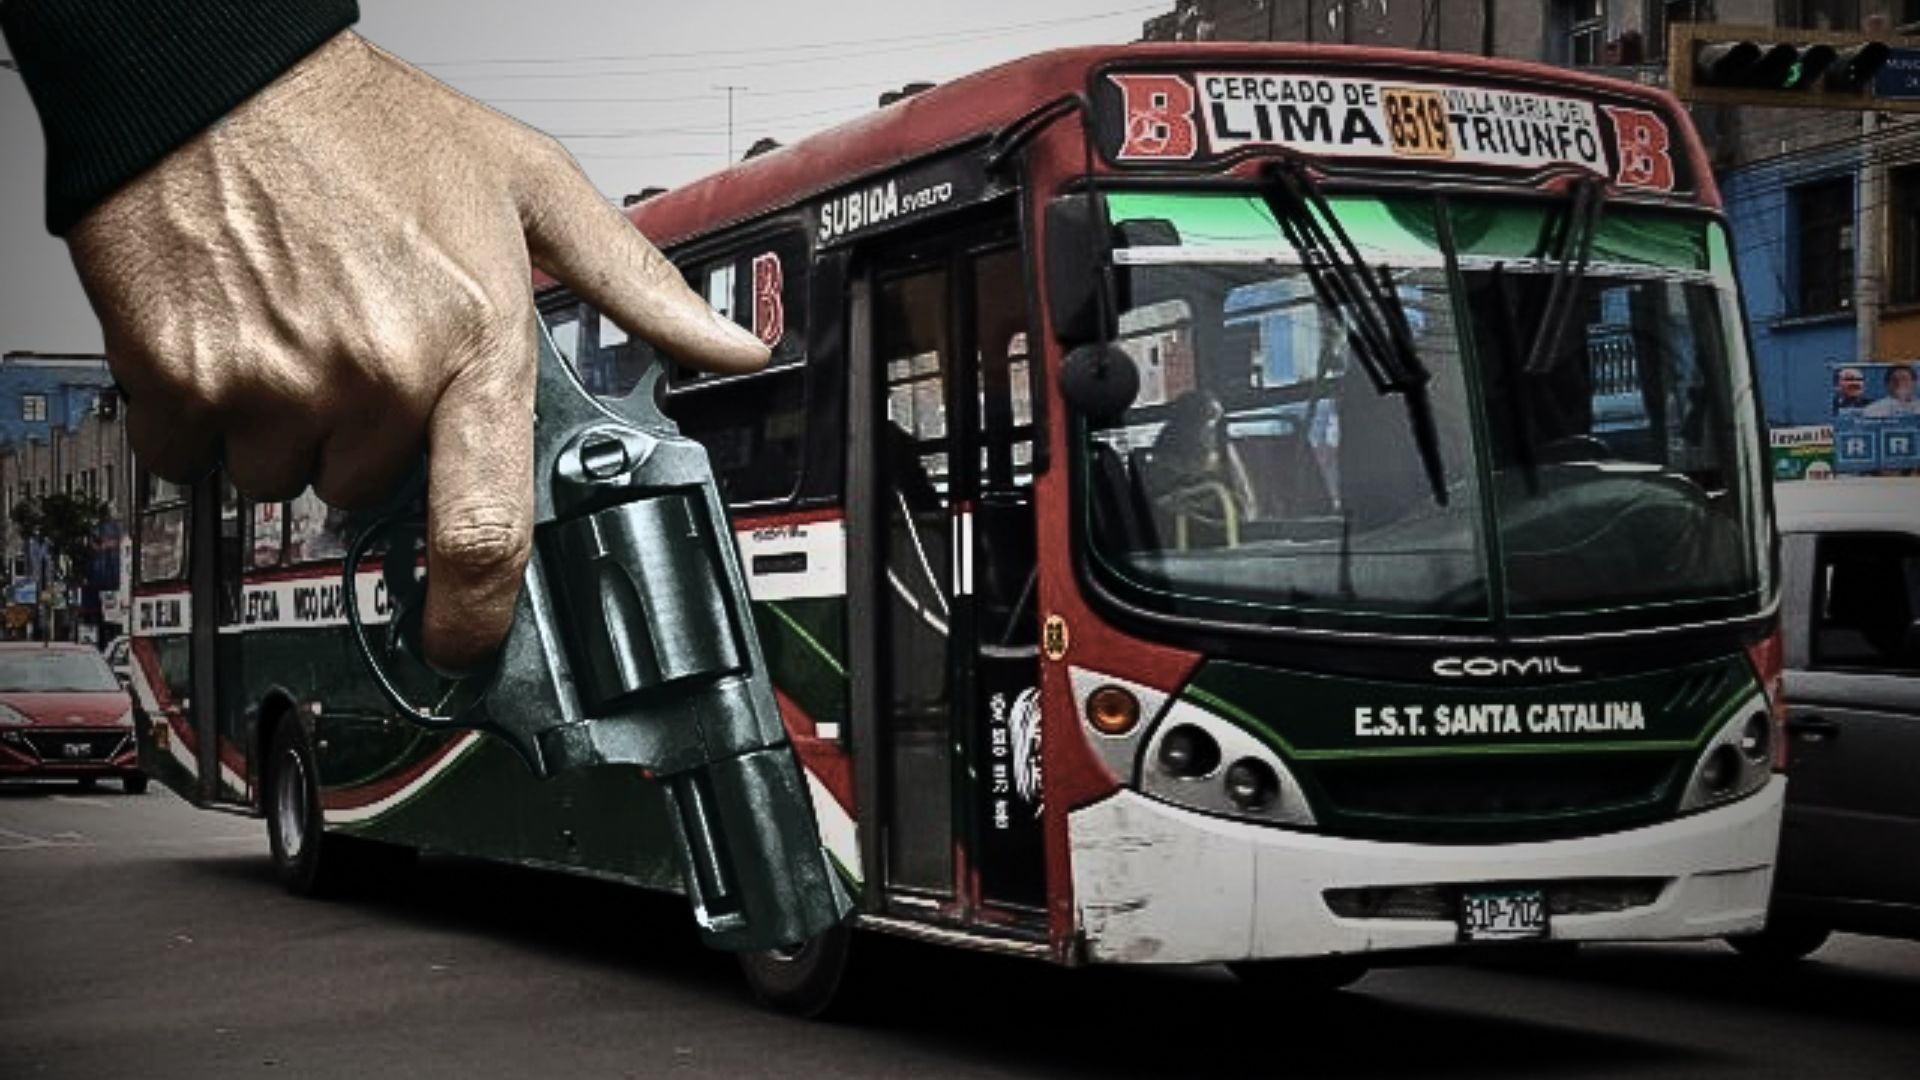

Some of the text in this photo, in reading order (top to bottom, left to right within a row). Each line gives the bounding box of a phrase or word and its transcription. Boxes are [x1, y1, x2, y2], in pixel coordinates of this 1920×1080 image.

[1205, 77, 1377, 107] CERCADO DE
[1443, 92, 1496, 113] VILLA
[1499, 94, 1552, 120] MARIA
[1209, 102, 1384, 145] LIMA
[1386, 92, 1448, 151] 8519
[1449, 114, 1597, 162] TRIUNFO
[820, 181, 898, 239] SUBIDA
[1432, 656, 1582, 678] COMIL
[1354, 700, 1645, 735] E.S.T. SANTA CATALINA
